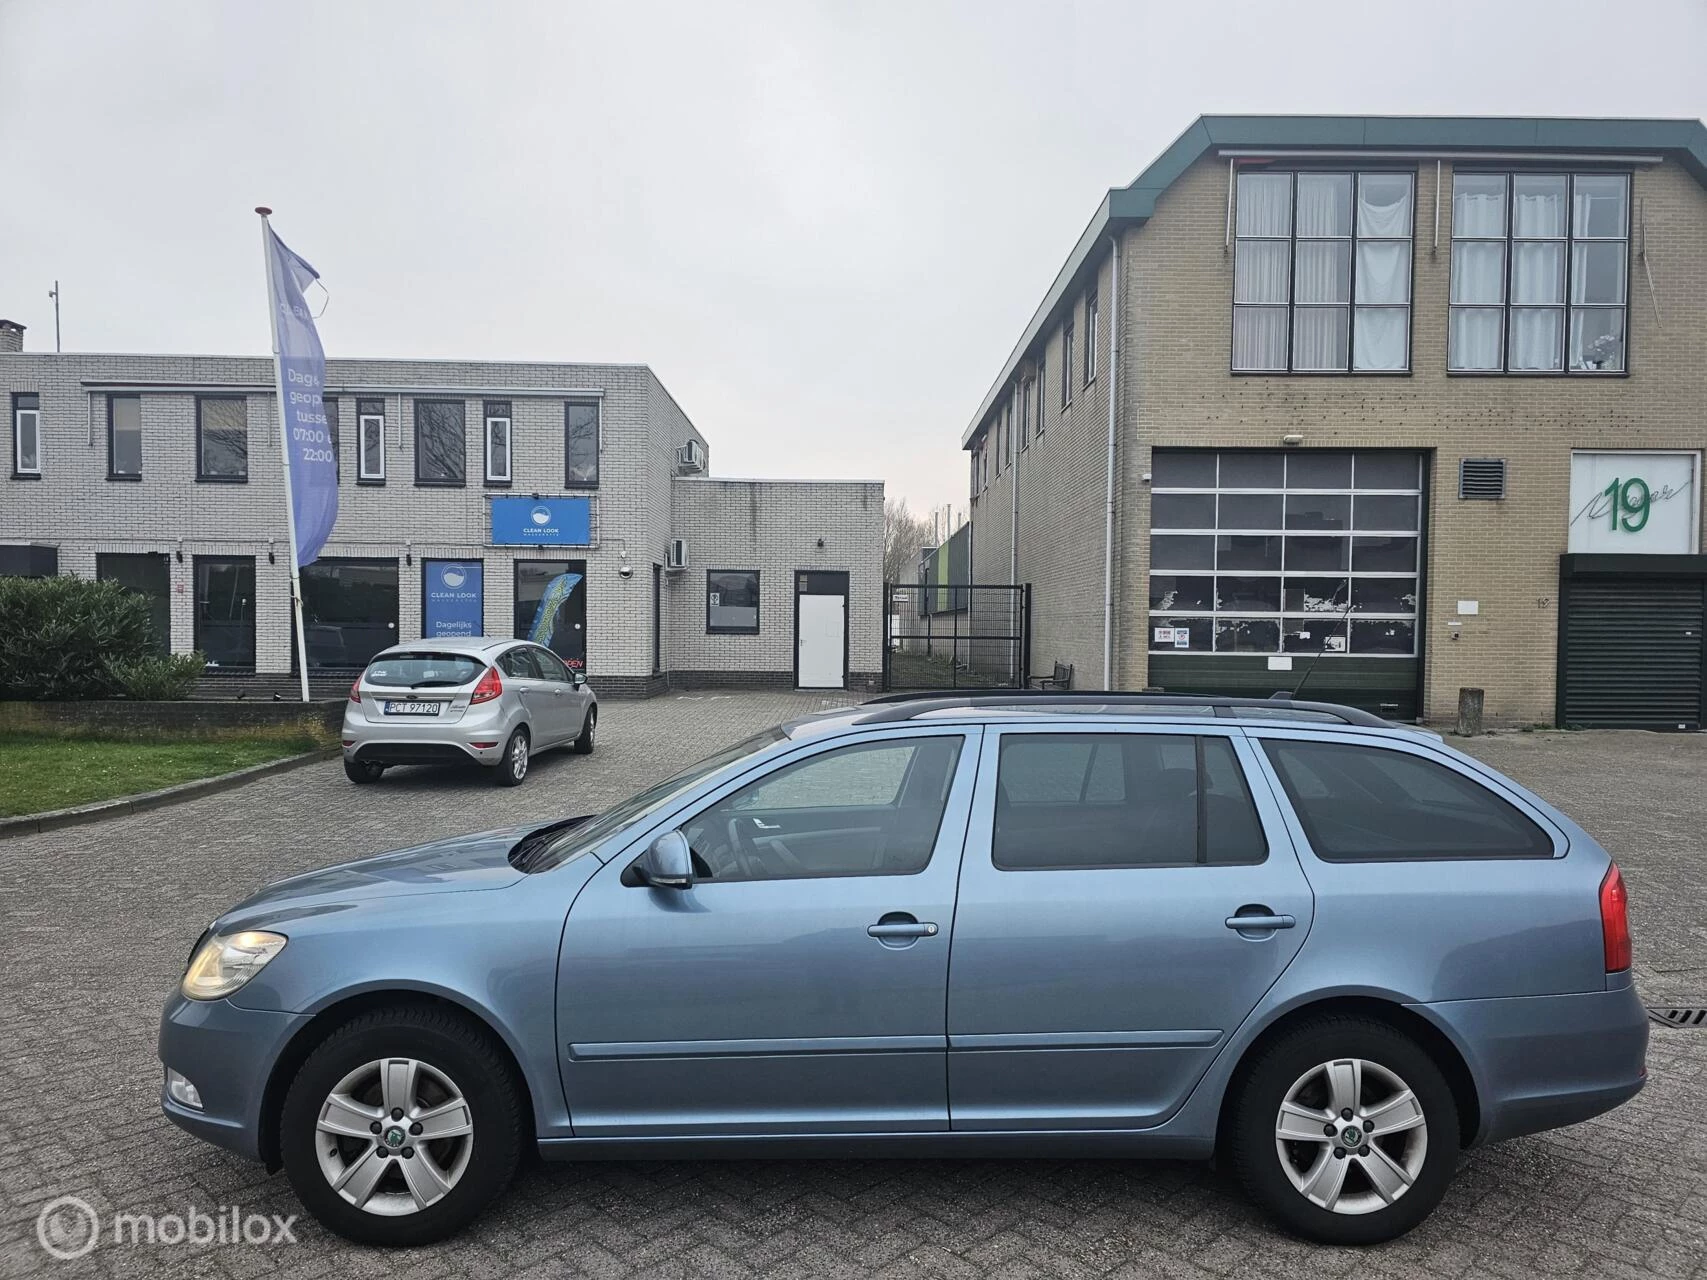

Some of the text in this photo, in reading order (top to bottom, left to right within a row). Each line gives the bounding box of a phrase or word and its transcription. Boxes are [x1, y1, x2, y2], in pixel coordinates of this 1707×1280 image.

[293, 427, 324, 443] 07:00
[303, 447, 333, 463] 22:00
[1605, 477, 1650, 532] 19
[436, 621, 472, 630] Dagelijks
[565, 660, 583, 668] PEN
[389, 703, 438, 713] PCT 97120
